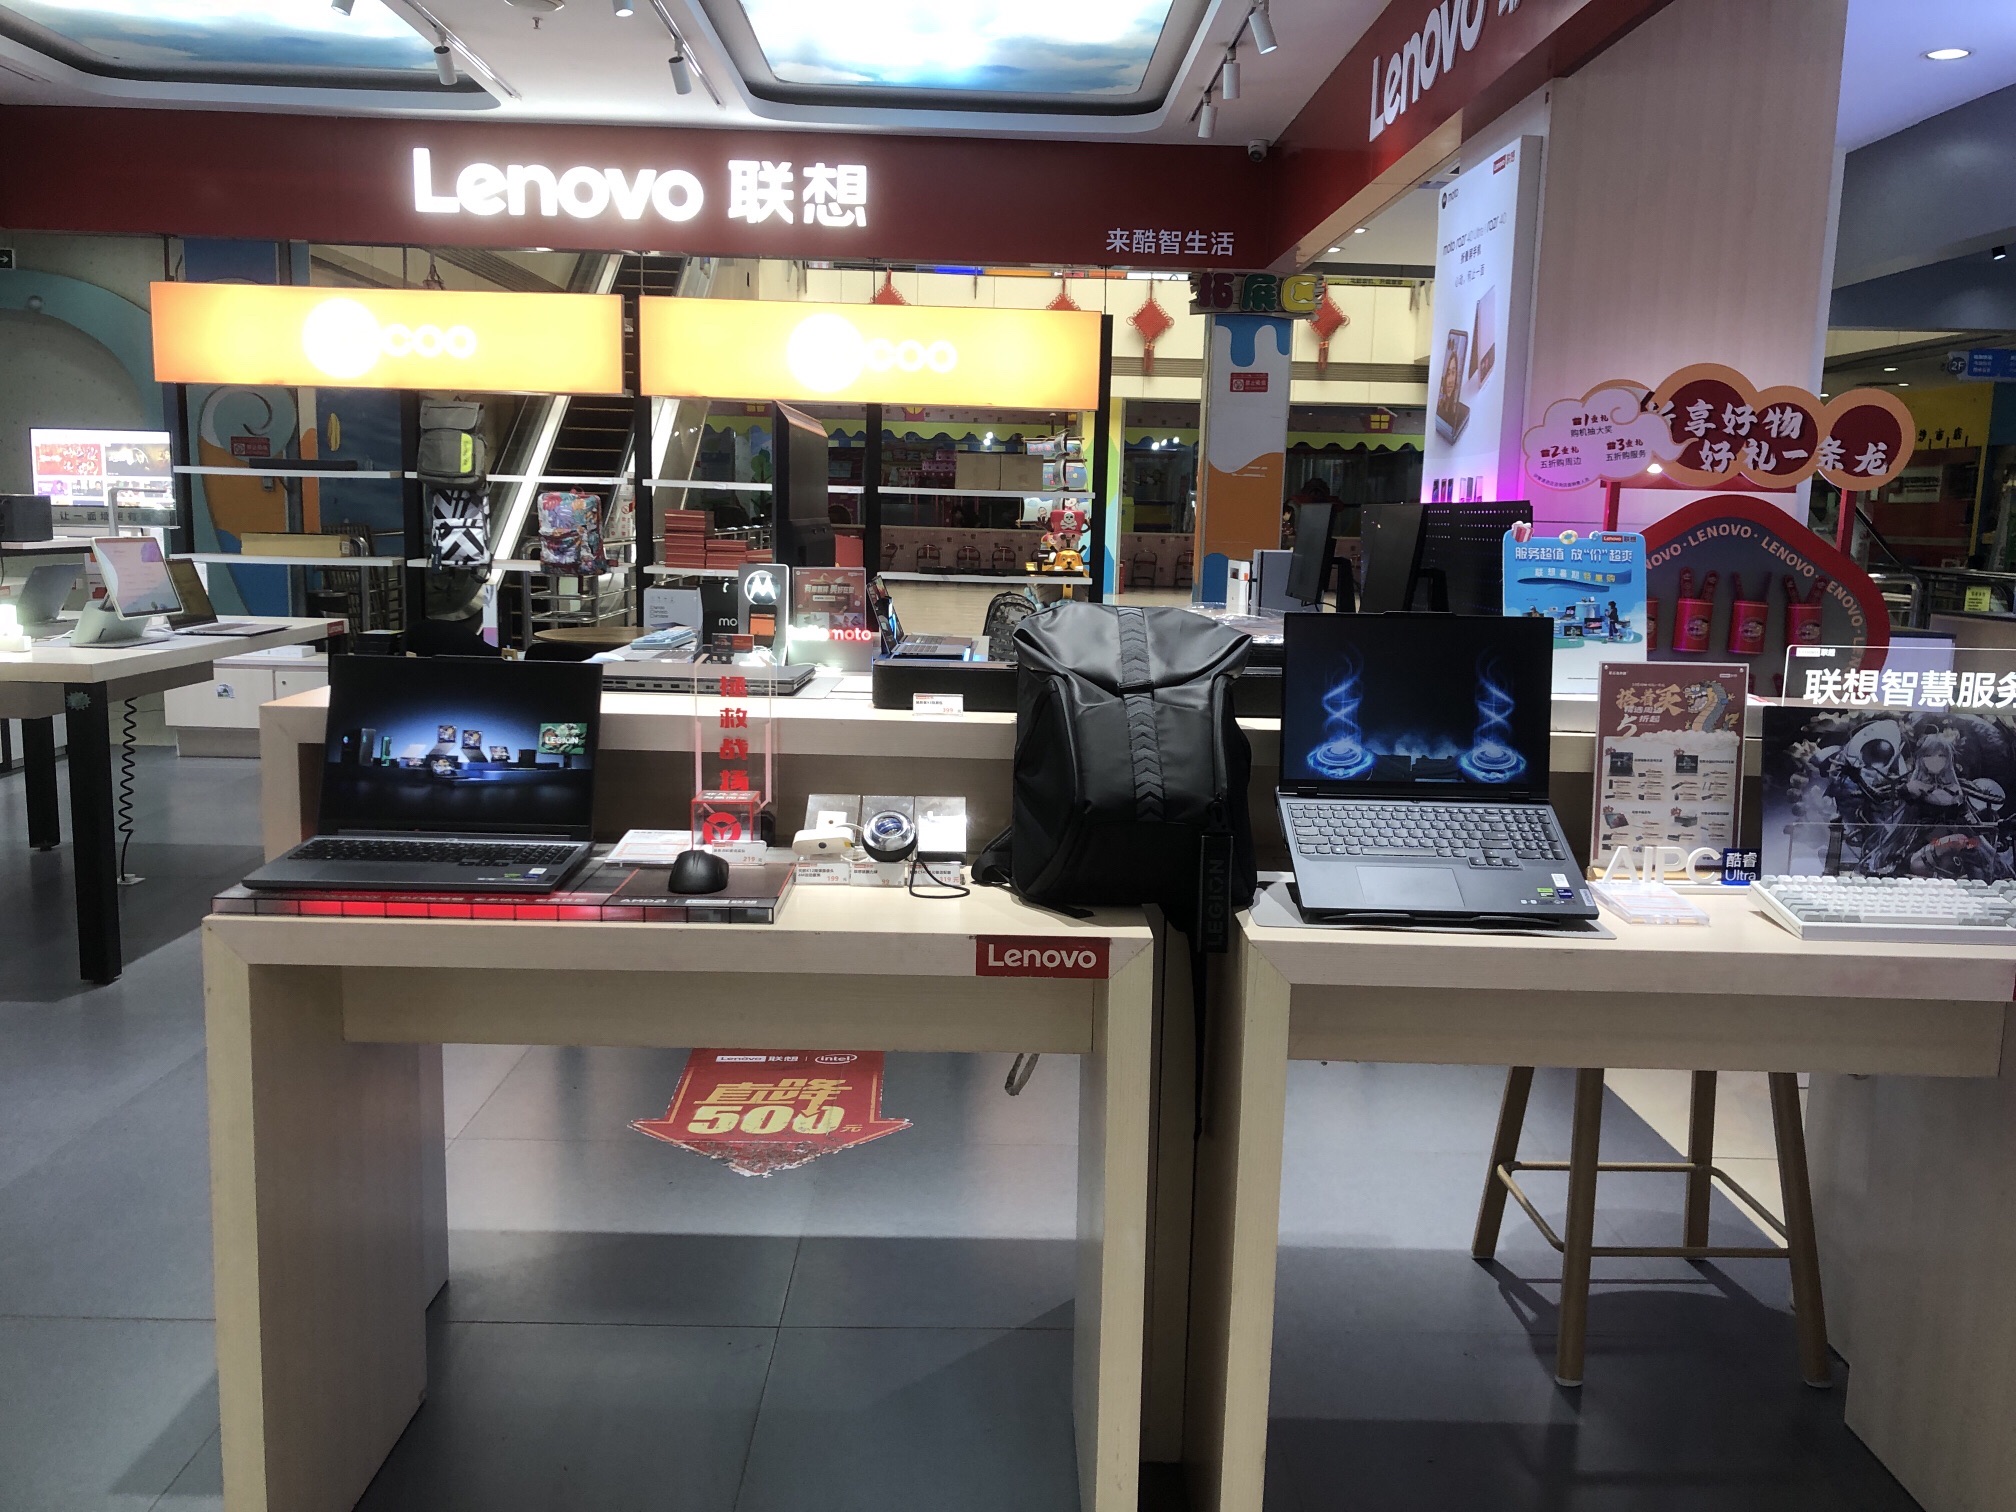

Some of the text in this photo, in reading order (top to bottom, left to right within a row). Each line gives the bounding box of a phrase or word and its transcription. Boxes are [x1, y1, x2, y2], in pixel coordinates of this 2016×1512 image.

[1369, 0, 1486, 142] Lenovo
[413, 148, 868, 227] Lenovo 联想
[1106, 227, 1235, 256] 来酷智生活
[1198, 272, 1318, 313] 拓展区
[1951, 361, 1965, 371] 2F
[1570, 426, 1613, 438] 购机抽大奖
[1540, 457, 1582, 469] 五折购周边
[1606, 449, 1646, 462] 五折购服务
[1699, 435, 1889, 476] 好礼一条龙
[1515, 547, 1564, 561] 服务超值
[1688, 523, 1752, 547] LENOVO
[1761, 536, 1815, 577] LENOVO
[1826, 580, 1864, 626] ENOVO
[832, 627, 872, 641] moto
[1803, 668, 2016, 709] 联想智慧服务
[545, 736, 579, 744] LEGION
[1601, 846, 1722, 886] AIPC
[1726, 851, 1758, 869] 酷睿
[1725, 869, 1757, 882] Ultra
[1208, 860, 1227, 946] LEGION
[987, 943, 1097, 969] Lenovo
[694, 1078, 852, 1114] 直降
[687, 1105, 845, 1135] 500
